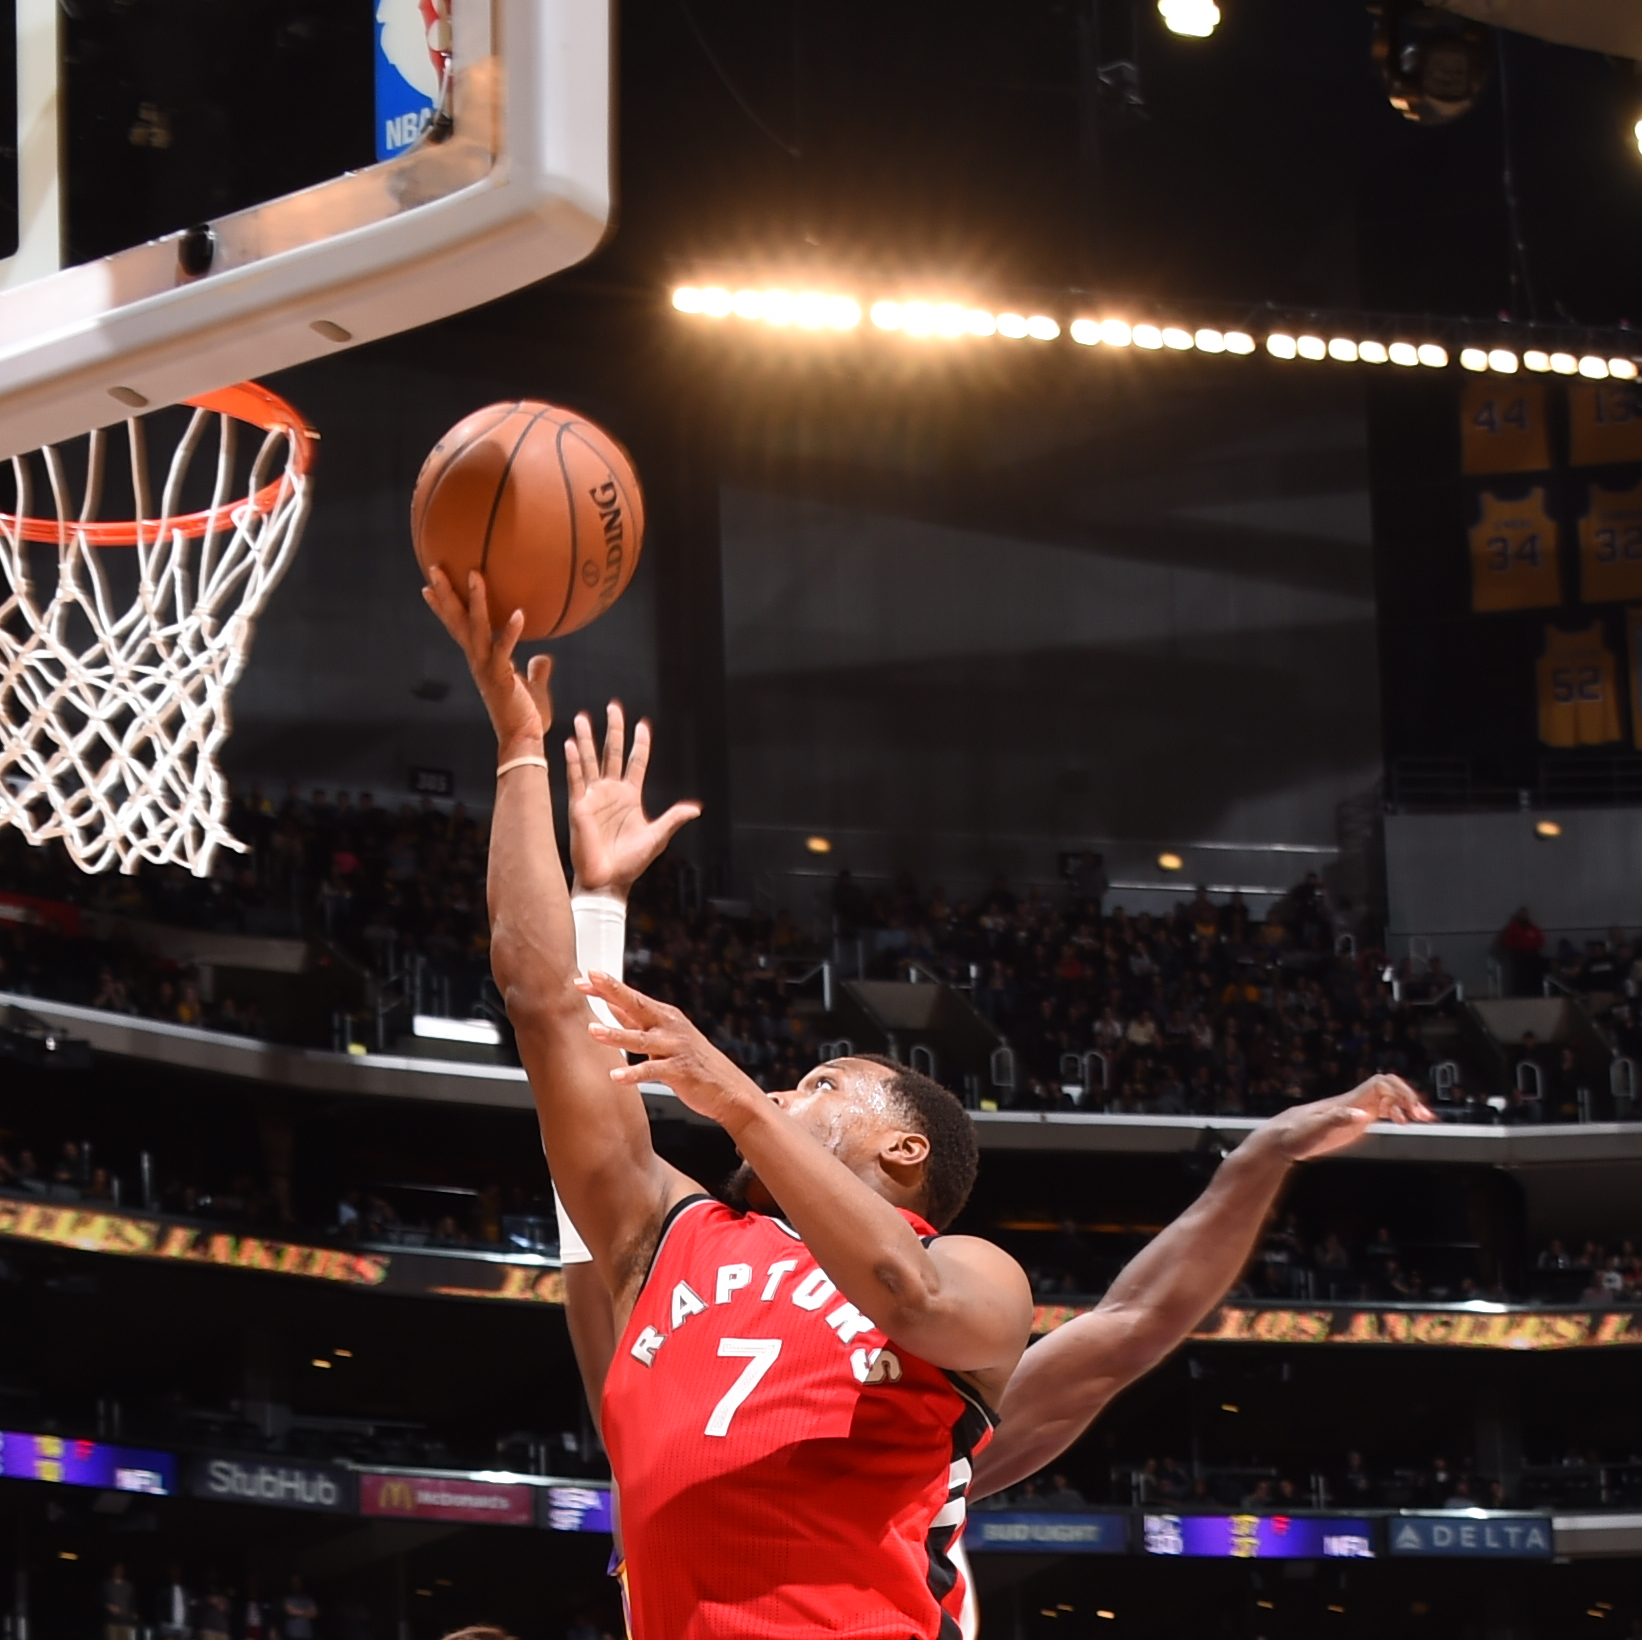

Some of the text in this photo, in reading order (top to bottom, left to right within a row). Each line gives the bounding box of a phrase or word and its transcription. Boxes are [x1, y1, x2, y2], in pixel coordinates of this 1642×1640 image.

[1472, 398, 1529, 434] 44
[591, 480, 623, 596] ALDING
[1487, 533, 1541, 571] 34
[159, 1226, 391, 1285] LAKERS
[504, 1264, 564, 1303] LO
[629, 1259, 903, 1386] RAPTORS
[1218, 1308, 1332, 1343] LOS
[1347, 1308, 1594, 1350] ANGELES
[704, 1337, 782, 1437] 7
[207, 1459, 337, 1507] StubHub
[1432, 1524, 1547, 1550] DELTA
